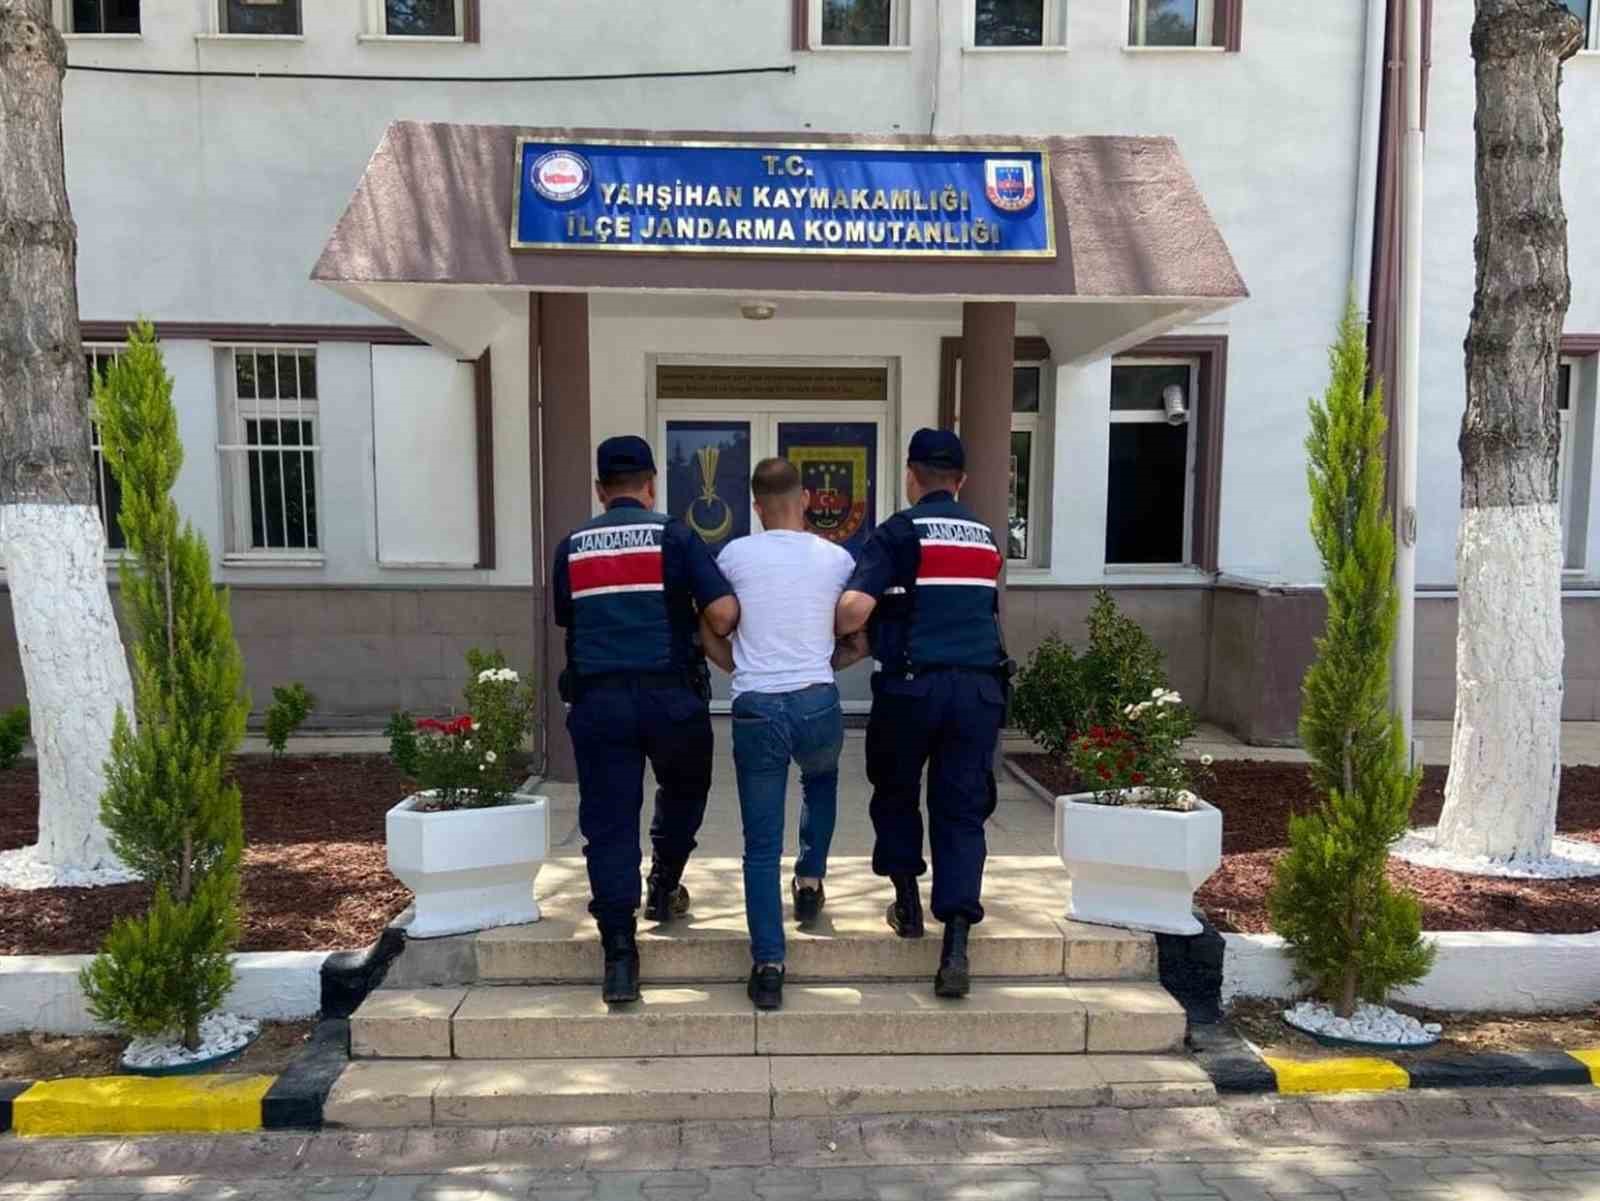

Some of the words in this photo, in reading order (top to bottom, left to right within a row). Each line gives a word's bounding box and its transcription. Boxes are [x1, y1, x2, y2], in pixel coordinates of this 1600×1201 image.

[761, 155, 814, 176] T.C.
[601, 178, 742, 211] YAHŞİHAN
[753, 184, 969, 211] KAYMAKAMLIĞI
[566, 210, 631, 242] İLÇE
[640, 216, 796, 240] JANDARMA
[804, 219, 1000, 244] KOMUTANLIĞI
[577, 529, 655, 552] JANDARMA
[926, 523, 991, 544] JANDARMA
